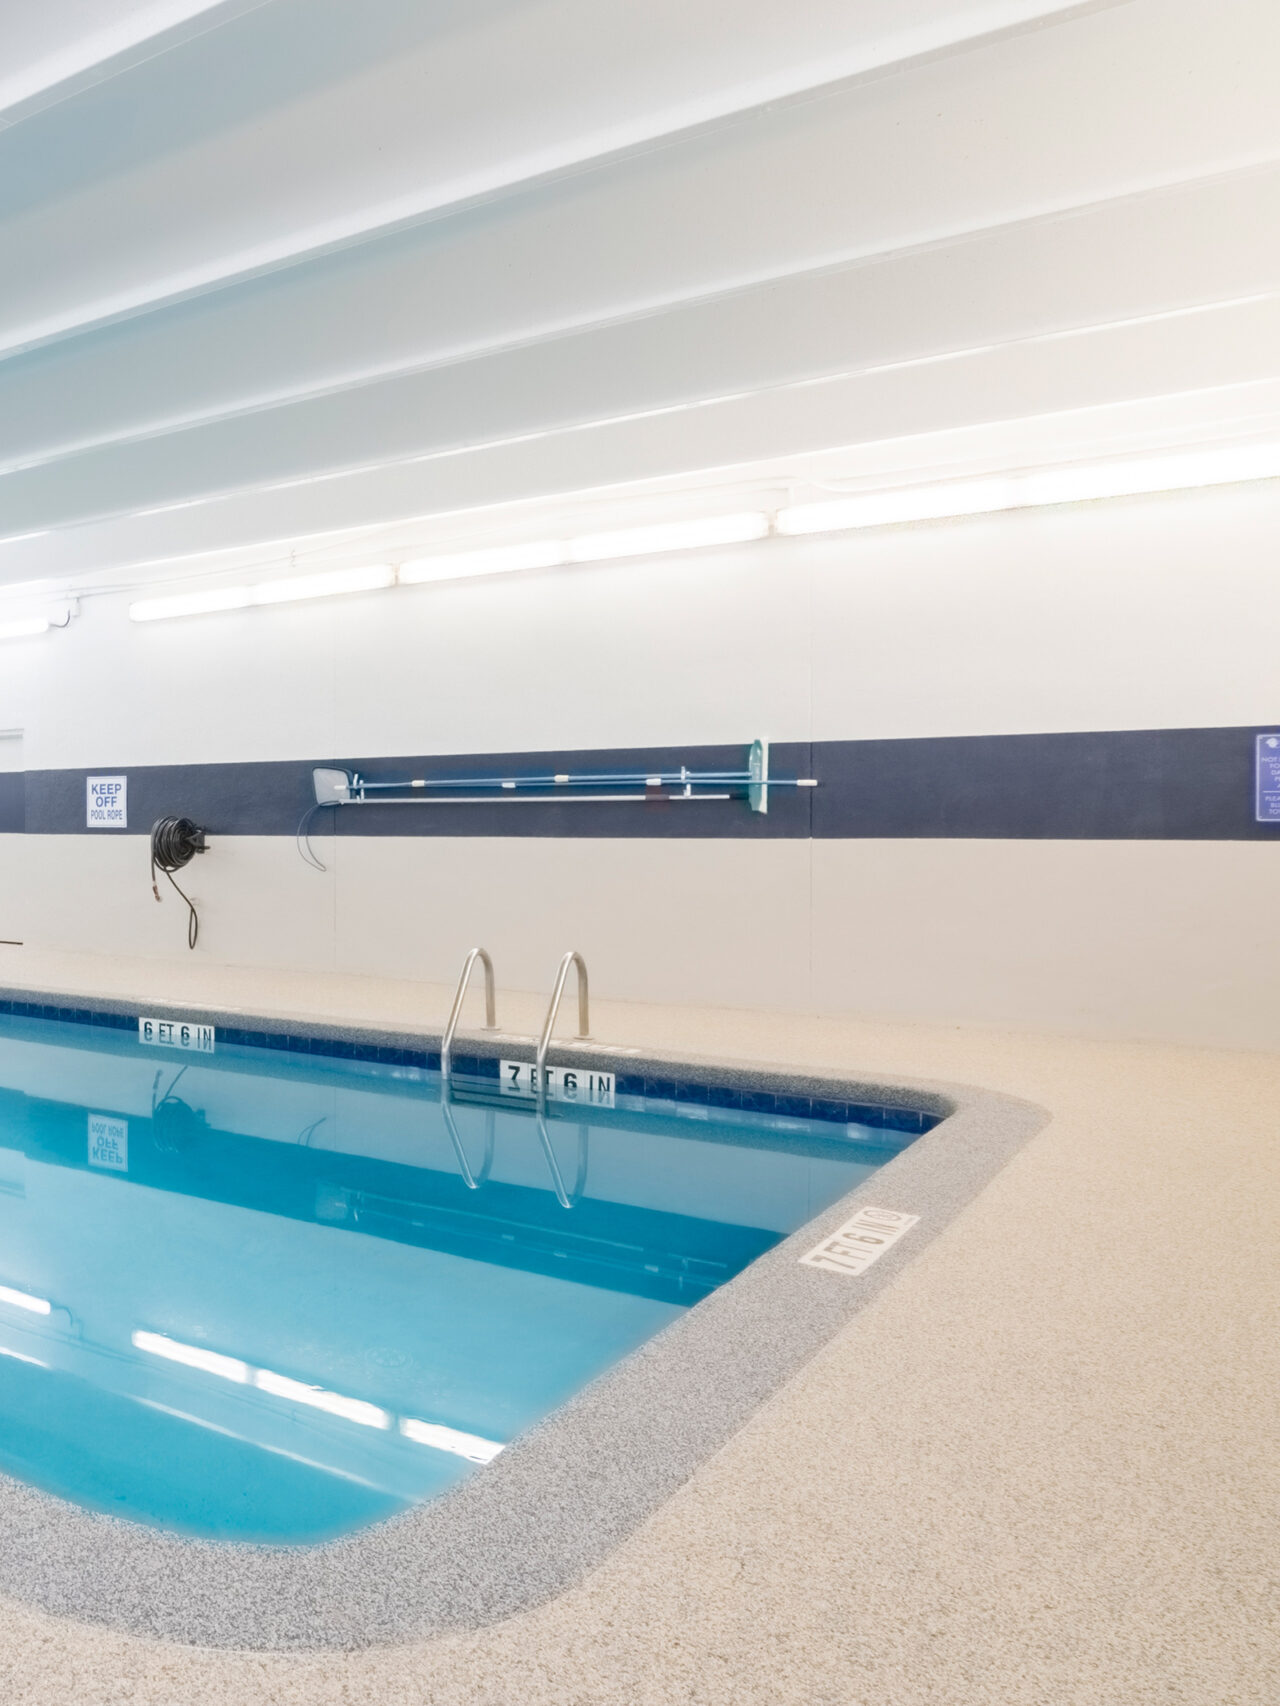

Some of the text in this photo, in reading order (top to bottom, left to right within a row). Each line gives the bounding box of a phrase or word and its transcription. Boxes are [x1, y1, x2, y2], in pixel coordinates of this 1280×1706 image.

[91, 783, 122, 795] KEEP
[95, 796, 118, 808] OFF
[90, 809, 123, 820] POOL ROPE
[144, 1021, 153, 1036] 6
[181, 1025, 190, 1041] 6
[197, 1026, 212, 1043] IN
[508, 1065, 521, 1082] 7
[563, 1072, 578, 1089] 6
[589, 1074, 611, 1093] IN
[841, 1232, 885, 1245] 6
[823, 1241, 874, 1261] FT
[809, 1253, 857, 1270] 7
